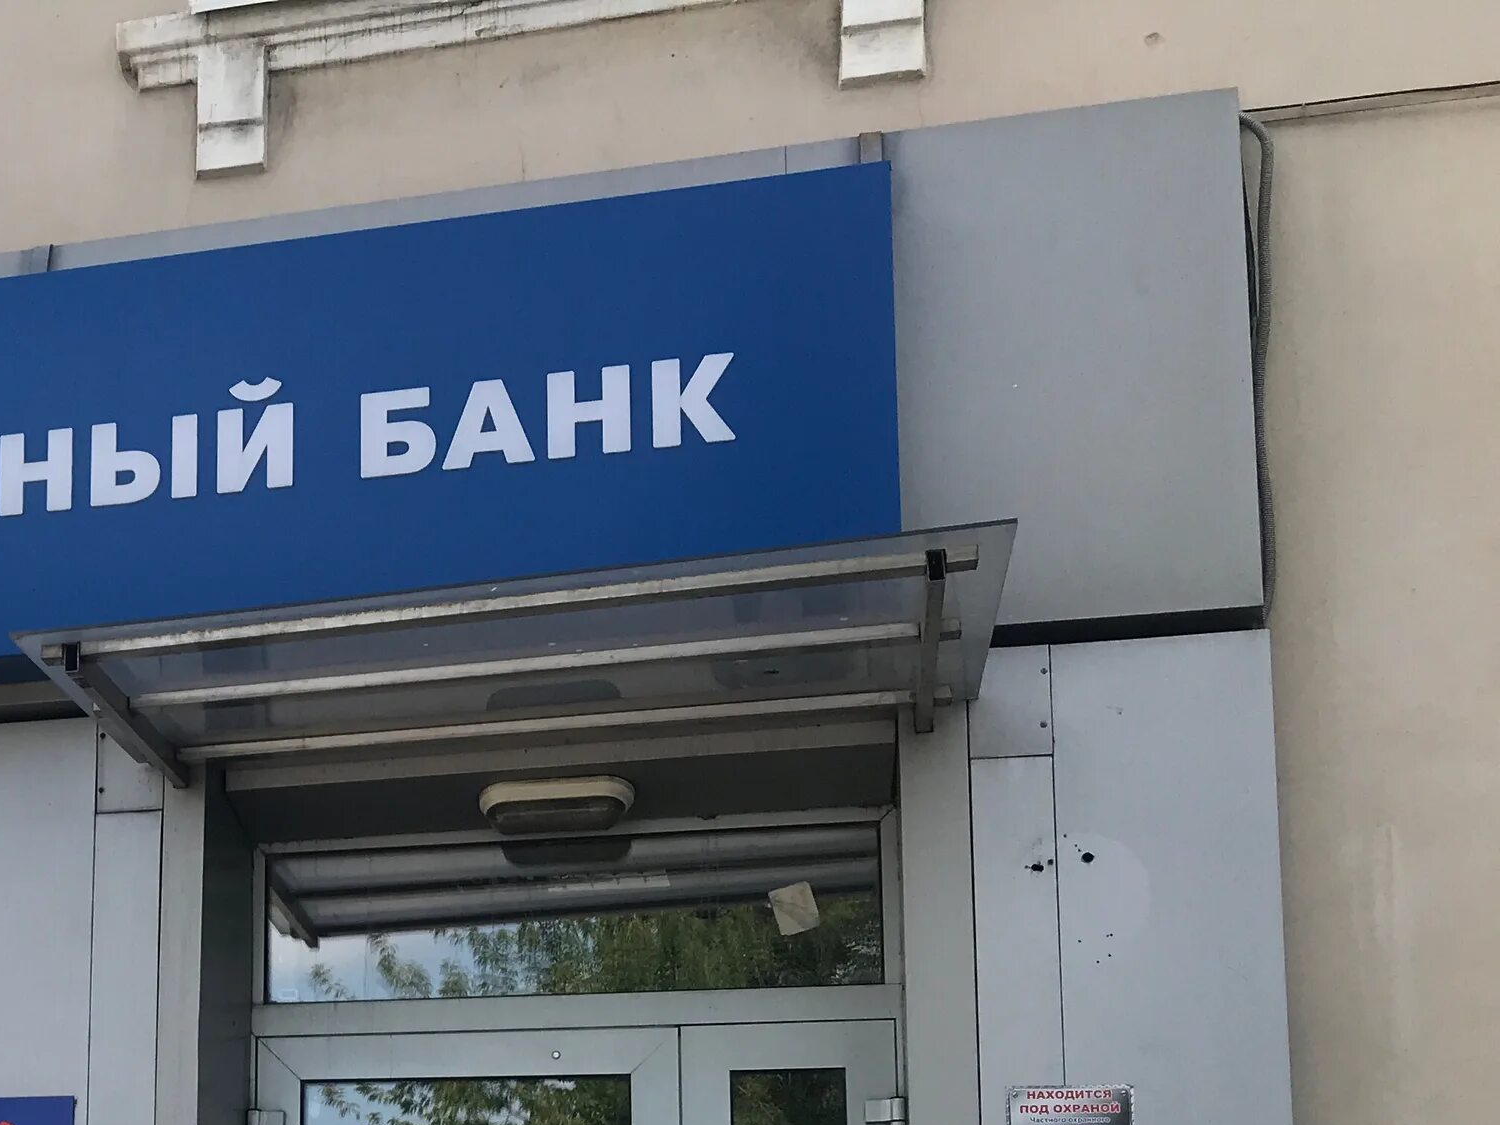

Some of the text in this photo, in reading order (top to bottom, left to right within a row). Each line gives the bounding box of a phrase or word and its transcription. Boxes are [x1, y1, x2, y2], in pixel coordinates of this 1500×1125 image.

[358, 351, 737, 479] БАНК
[1026, 1089, 1113, 1101] НАХОДИТСЯ
[1019, 1102, 1121, 1115] ПОД ОХРАНОЙ
